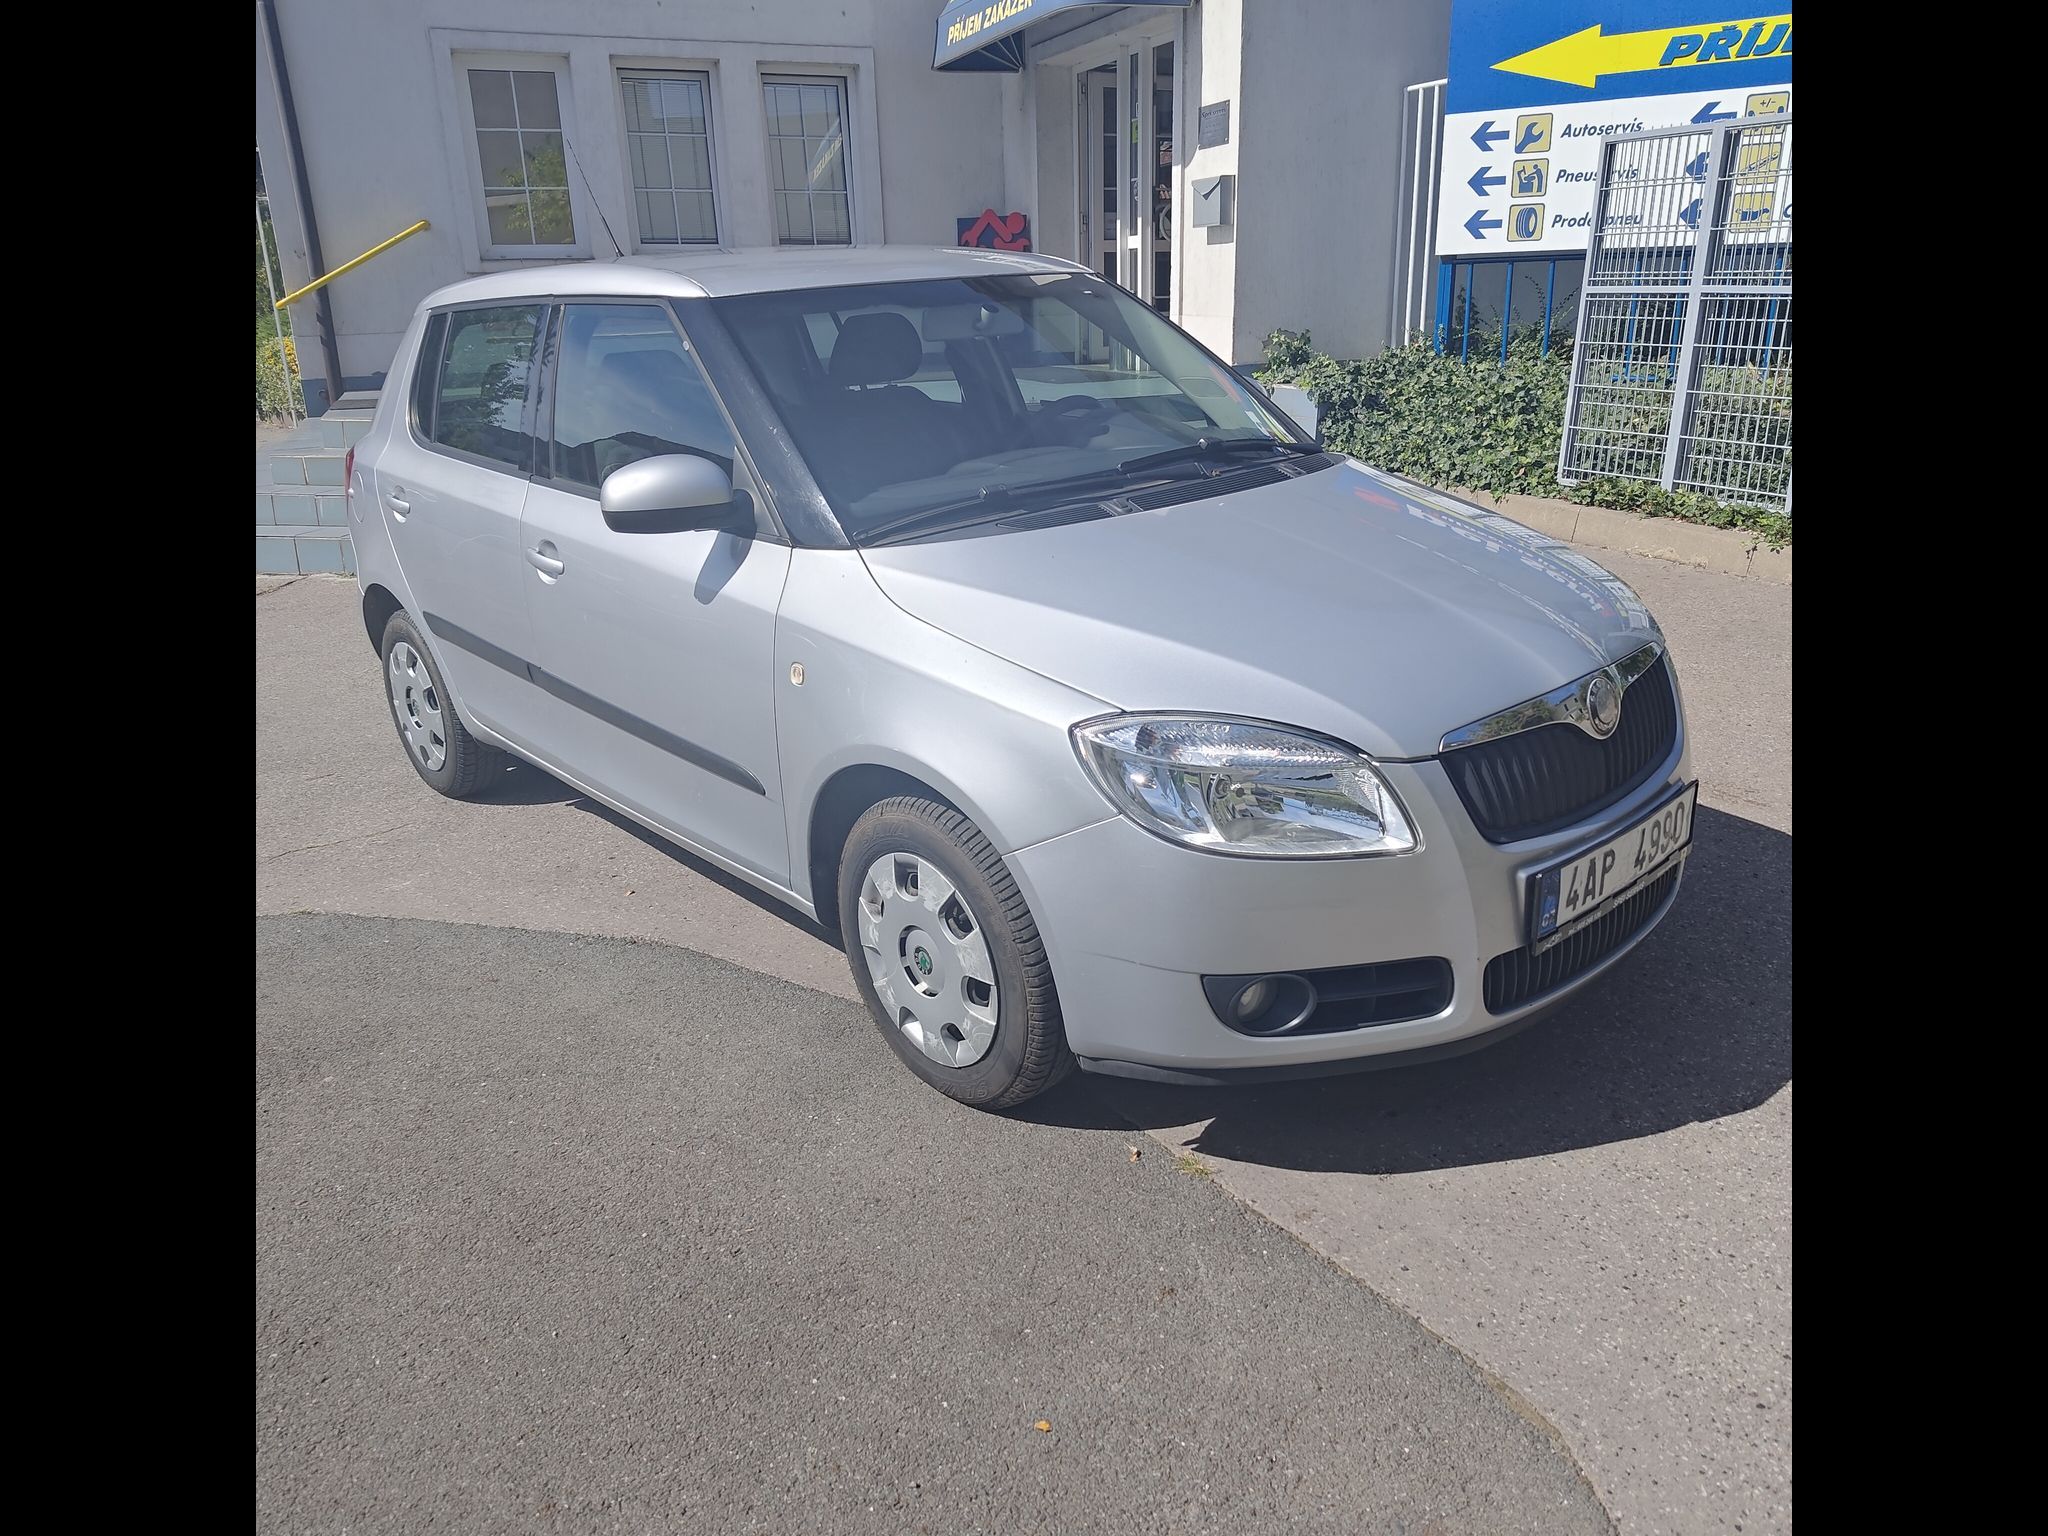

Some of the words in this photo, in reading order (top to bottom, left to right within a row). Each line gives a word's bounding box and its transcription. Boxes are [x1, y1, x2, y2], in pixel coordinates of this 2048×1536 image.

[947, 11, 983, 46] PŘÍJEM
[1560, 117, 1643, 138] Autoservis
[1556, 164, 1638, 183] Pneurvis
[1565, 848, 1616, 911] 4AP
[1633, 801, 1685, 871] 4990
